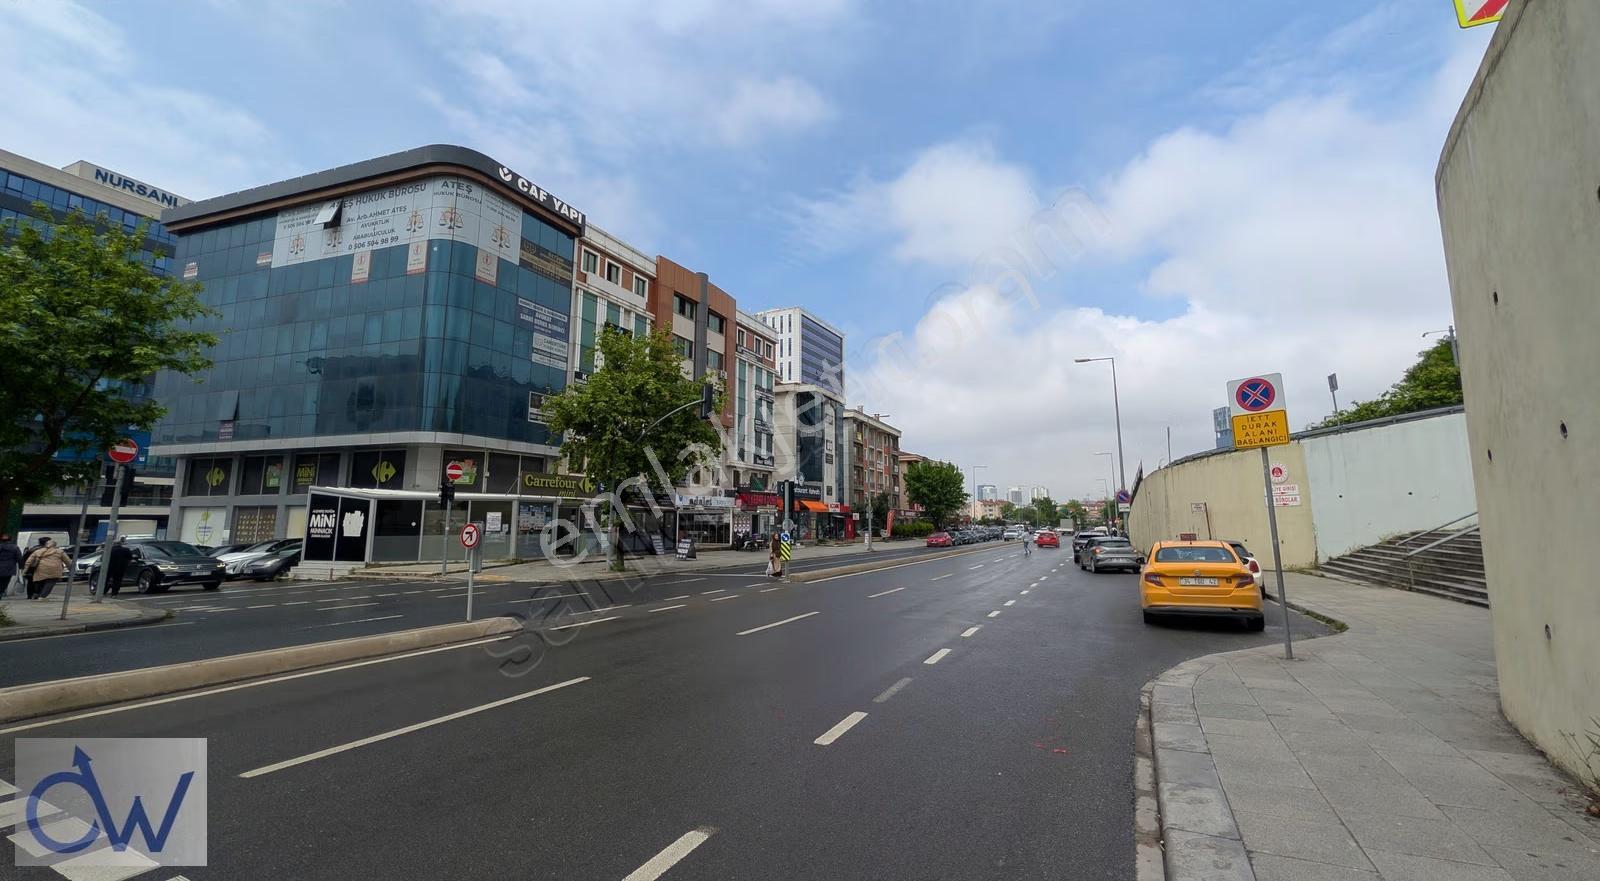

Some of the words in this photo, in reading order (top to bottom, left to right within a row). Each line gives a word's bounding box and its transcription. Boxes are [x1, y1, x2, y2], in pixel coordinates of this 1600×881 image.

[441, 180, 473, 193] ATEŞ
[356, 191, 387, 206] HUKUK
[388, 183, 427, 199] BÜROSU
[517, 178, 548, 203] CAF
[552, 197, 582, 225] YAPI
[369, 209, 391, 219] AHMET
[353, 242, 366, 250] 506
[1241, 420, 1277, 431] DURAK
[1244, 429, 1277, 437] ALANI
[524, 473, 577, 489] Carrefour
[558, 488, 576, 498] mini
